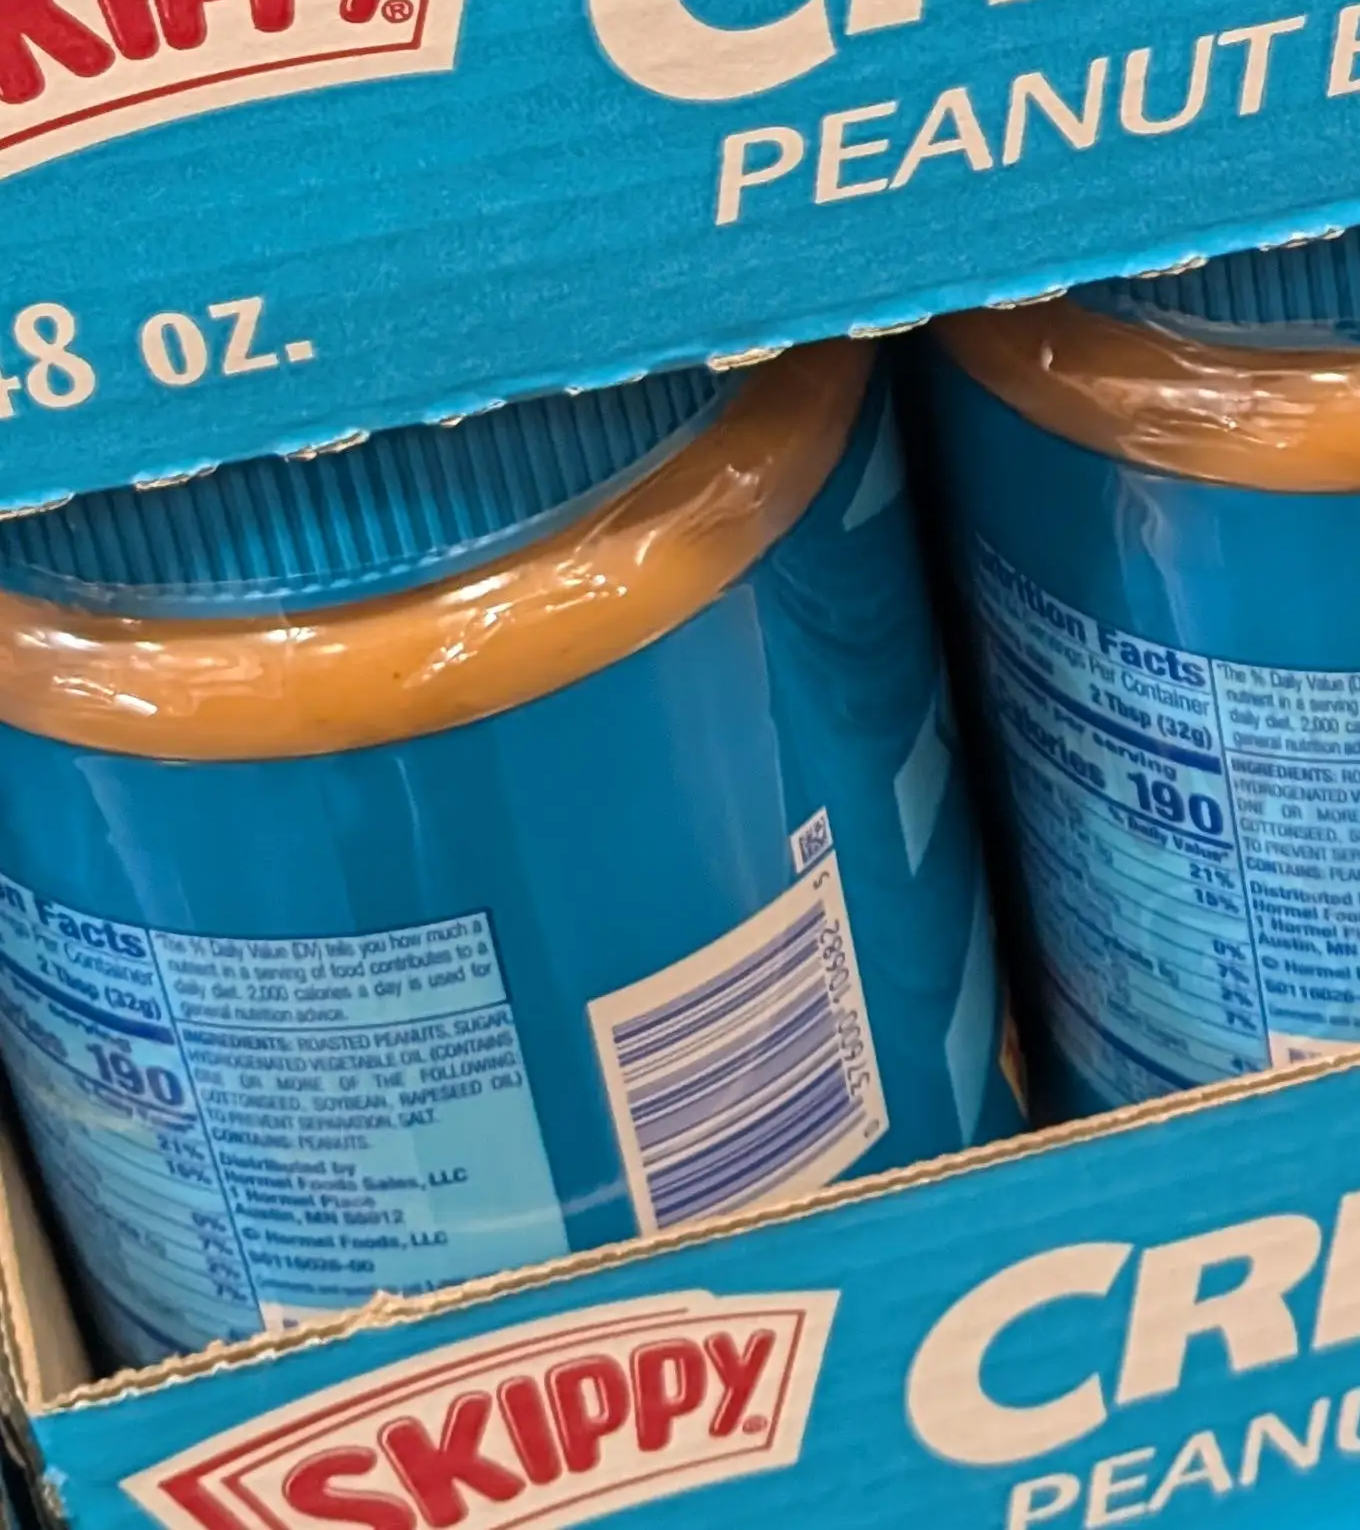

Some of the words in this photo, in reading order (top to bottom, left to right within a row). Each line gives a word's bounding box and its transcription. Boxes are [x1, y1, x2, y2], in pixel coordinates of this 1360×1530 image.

[715, 15, 1304, 226] PEANUT
[140, 297, 313, 386] oz.
[1099, 627, 1207, 688] Facts
[1127, 770, 1223, 836] 190
[40, 898, 146, 960] Facts
[85, 1040, 186, 1107] 190
[281, 1330, 776, 1530] SKIPPY
